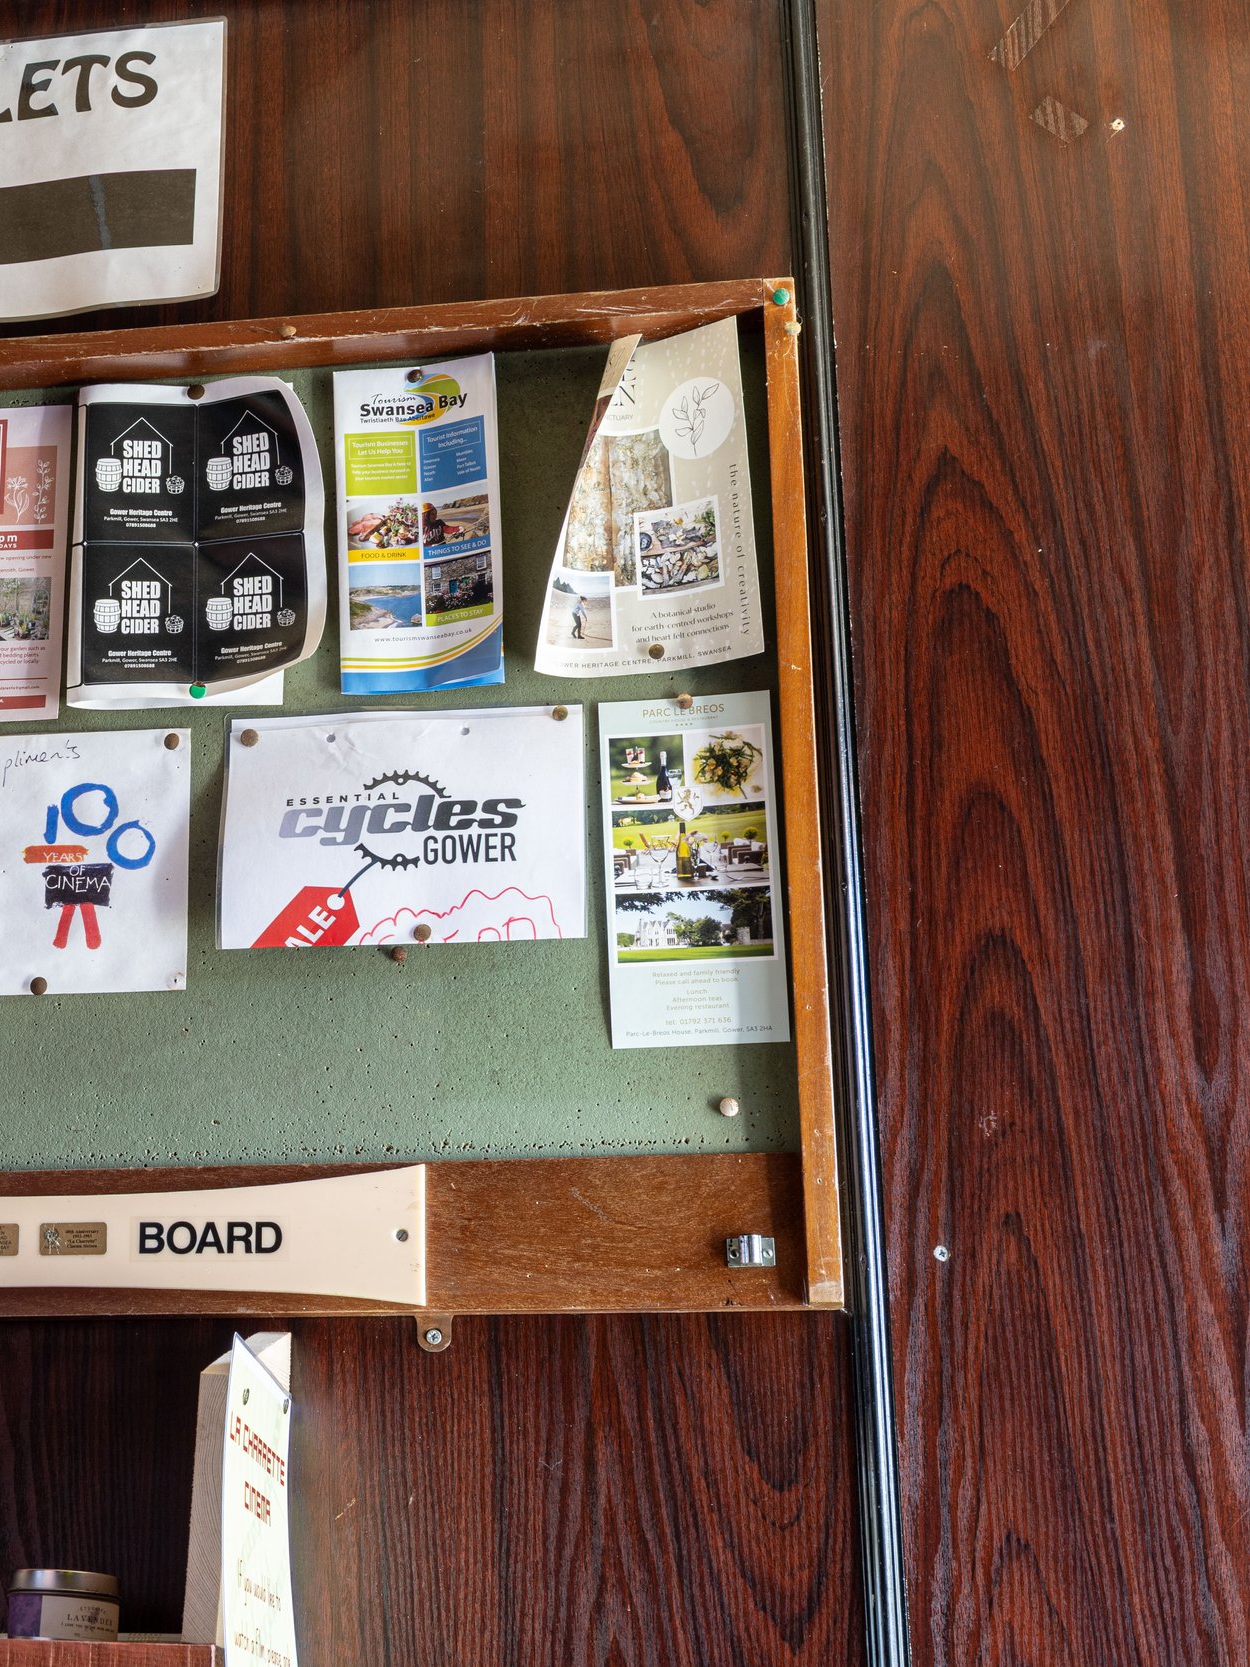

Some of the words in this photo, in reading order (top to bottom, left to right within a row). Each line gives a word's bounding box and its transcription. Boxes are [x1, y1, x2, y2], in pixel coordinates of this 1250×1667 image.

[360, 401, 434, 417] Swansea
[439, 393, 468, 409] Bay
[371, 394, 416, 404] Tourism
[233, 432, 270, 454] SHED
[427, 434, 446, 443] Tourist
[446, 426, 478, 438] Information
[123, 440, 162, 459] SHED
[123, 459, 162, 477] HEAD
[233, 452, 270, 473] HEAD
[233, 472, 270, 490] CIDER
[728, 464, 738, 486] the
[123, 478, 160, 494] CIDER
[128, 509, 152, 517] Heritage
[732, 493, 742, 538] nature
[428, 546, 450, 556] THINGS
[735, 545, 745, 559] of
[121, 581, 161, 599] SHED
[233, 575, 272, 596] SHED
[121, 600, 160, 618] HEAD
[233, 595, 272, 614] HEAD
[738, 565, 751, 635] creativity
[438, 612, 459, 622] PLACES
[470, 608, 484, 616] STAY
[658, 607, 693, 618] botanical
[694, 604, 715, 612] studio
[121, 619, 159, 634] CIDER
[233, 614, 271, 631] CIDER
[644, 618, 696, 631] earth-centred
[697, 612, 734, 624] workshops
[374, 628, 472, 642] www.tourismswanseabay.co.uk
[636, 635, 650, 643] and
[651, 632, 671, 642] heart
[673, 631, 685, 639] felt
[686, 624, 729, 637] connections
[622, 658, 654, 666] CENTRE,
[657, 653, 695, 663] PARKMILL,
[698, 645, 732, 656] SWANSEA
[642, 707, 671, 718] PARC
[674, 707, 686, 716] LE
[689, 703, 725, 715] BREOS
[286, 792, 400, 806] ESSENTIAL
[42, 782, 156, 870] 100
[278, 794, 527, 846] cycles
[43, 852, 85, 863] YEARS
[423, 832, 516, 865] GOWER
[69, 865, 85, 876] OF
[45, 874, 112, 892] CINEMA
[284, 905, 336, 947] ALE
[138, 1222, 283, 1255] BOARD
[230, 1410, 241, 1446] LA
[243, 1424, 284, 1487] CHARRETTE
[244, 1481, 271, 1527] CINEMA
